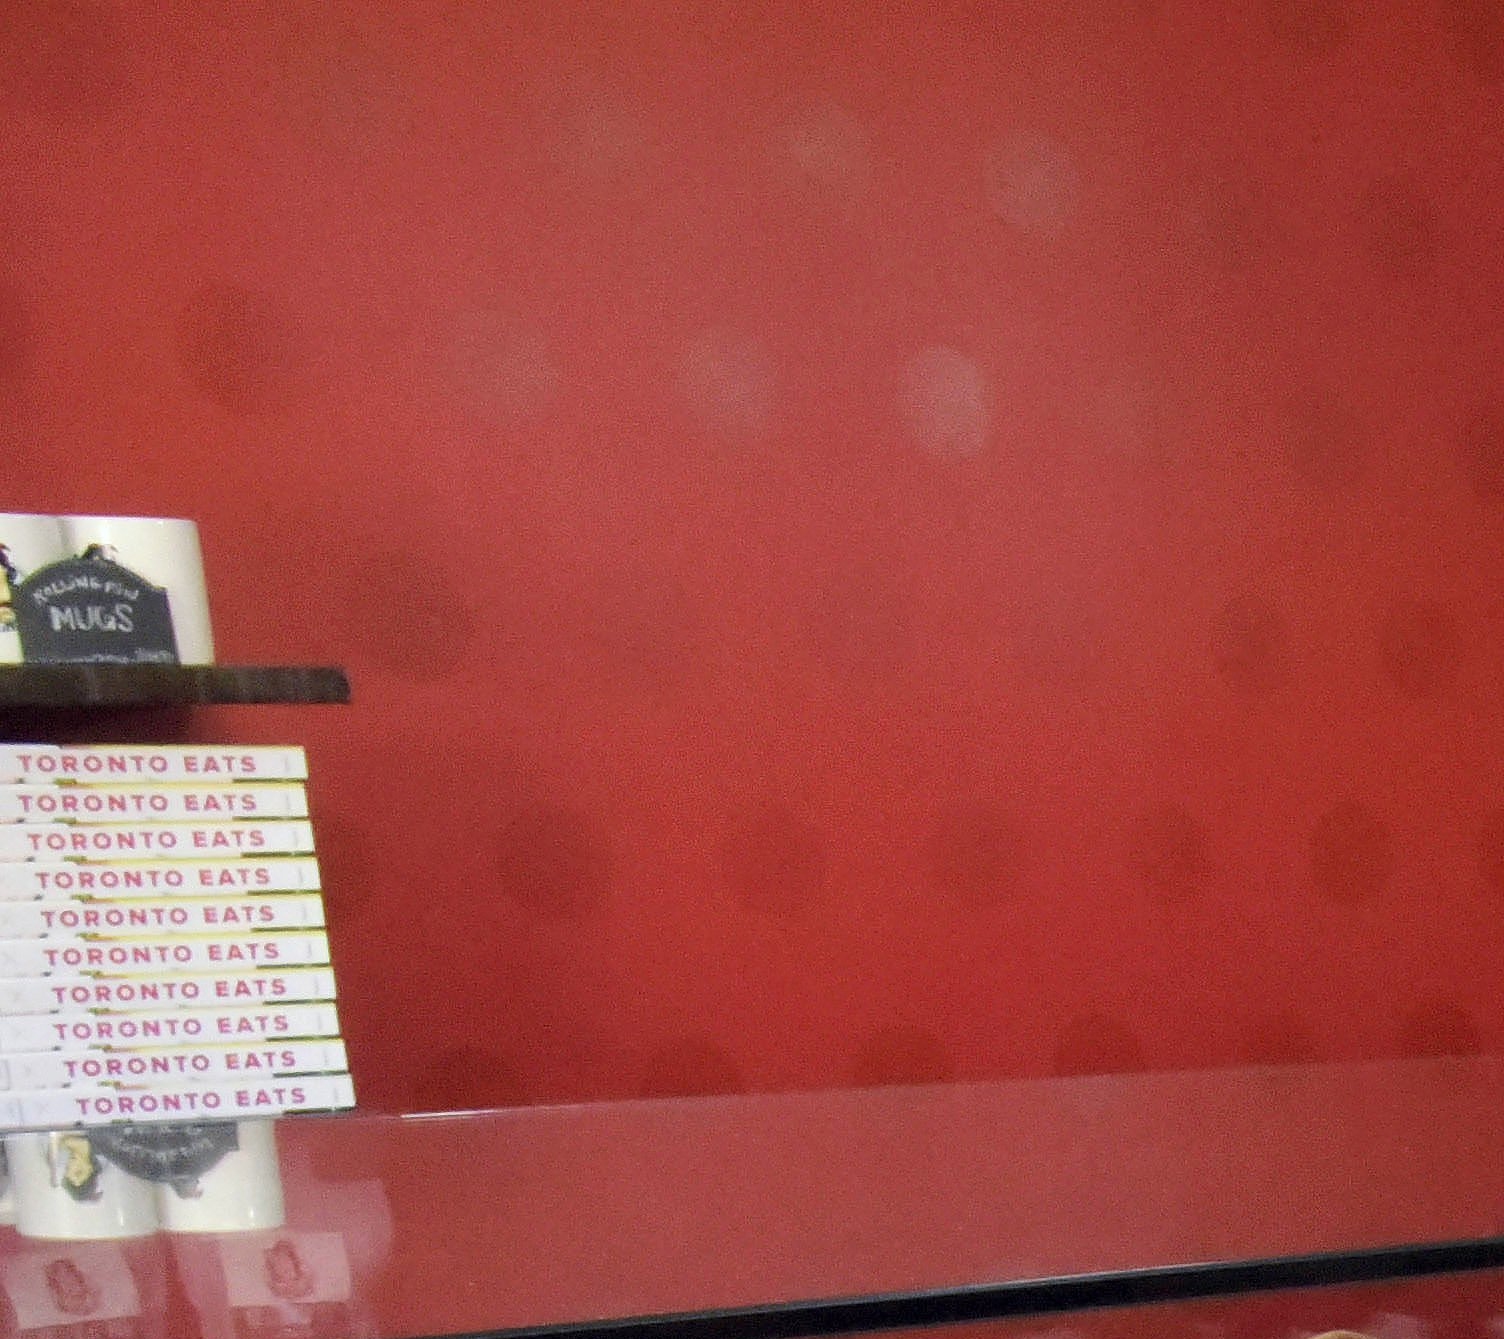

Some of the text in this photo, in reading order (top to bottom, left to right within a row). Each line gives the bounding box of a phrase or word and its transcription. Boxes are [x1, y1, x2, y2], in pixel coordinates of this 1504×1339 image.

[49, 603, 135, 634] MUGS
[17, 755, 257, 773] TORONTO EATS
[17, 794, 257, 812] TORONTO EATS
[27, 830, 266, 851] TORONTO EATS
[35, 867, 271, 890] TORONTO EATS
[41, 905, 275, 928] TORONTO EATS
[43, 943, 280, 966] TORONTO EATS
[52, 978, 287, 1003] TORONTO EATS
[53, 1015, 289, 1040] TORONTO EATS
[63, 1050, 296, 1077] TORONTO EATS
[76, 1088, 306, 1114] TORONTO EATS
